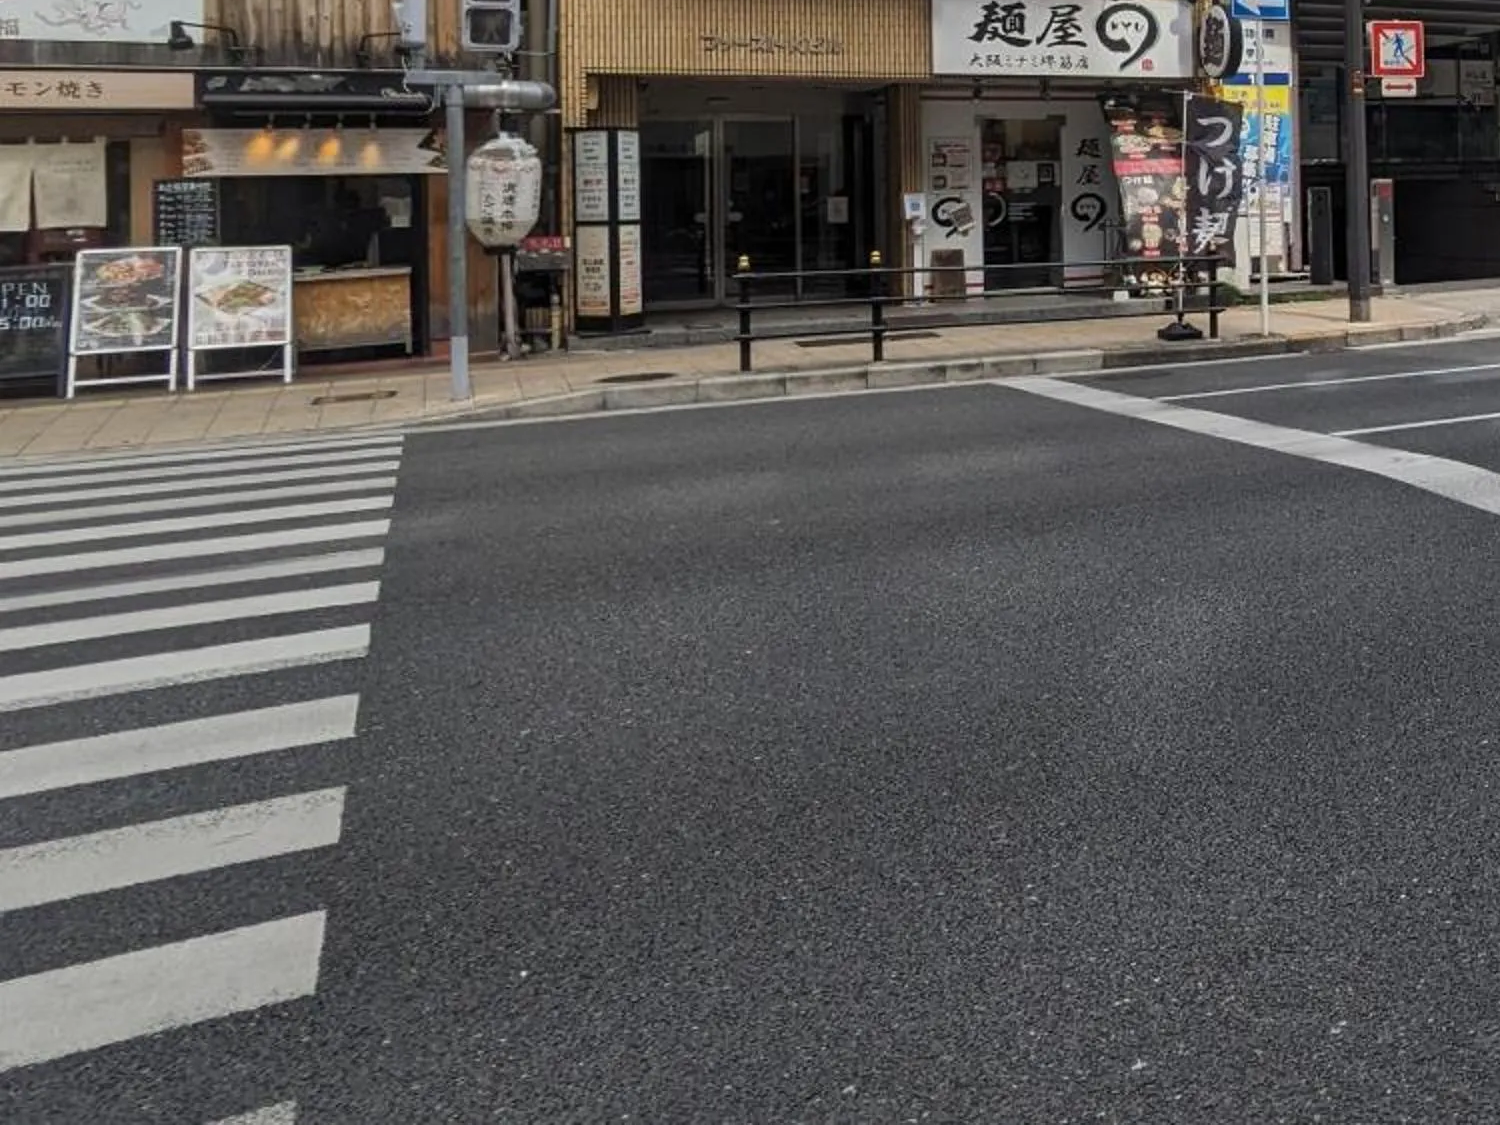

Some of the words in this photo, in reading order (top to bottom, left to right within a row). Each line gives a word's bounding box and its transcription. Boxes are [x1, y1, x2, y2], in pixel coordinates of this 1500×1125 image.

[968, 53, 1090, 71] 大阪ミナミ堺筋店
[1192, 115, 1238, 254] つけ麺
